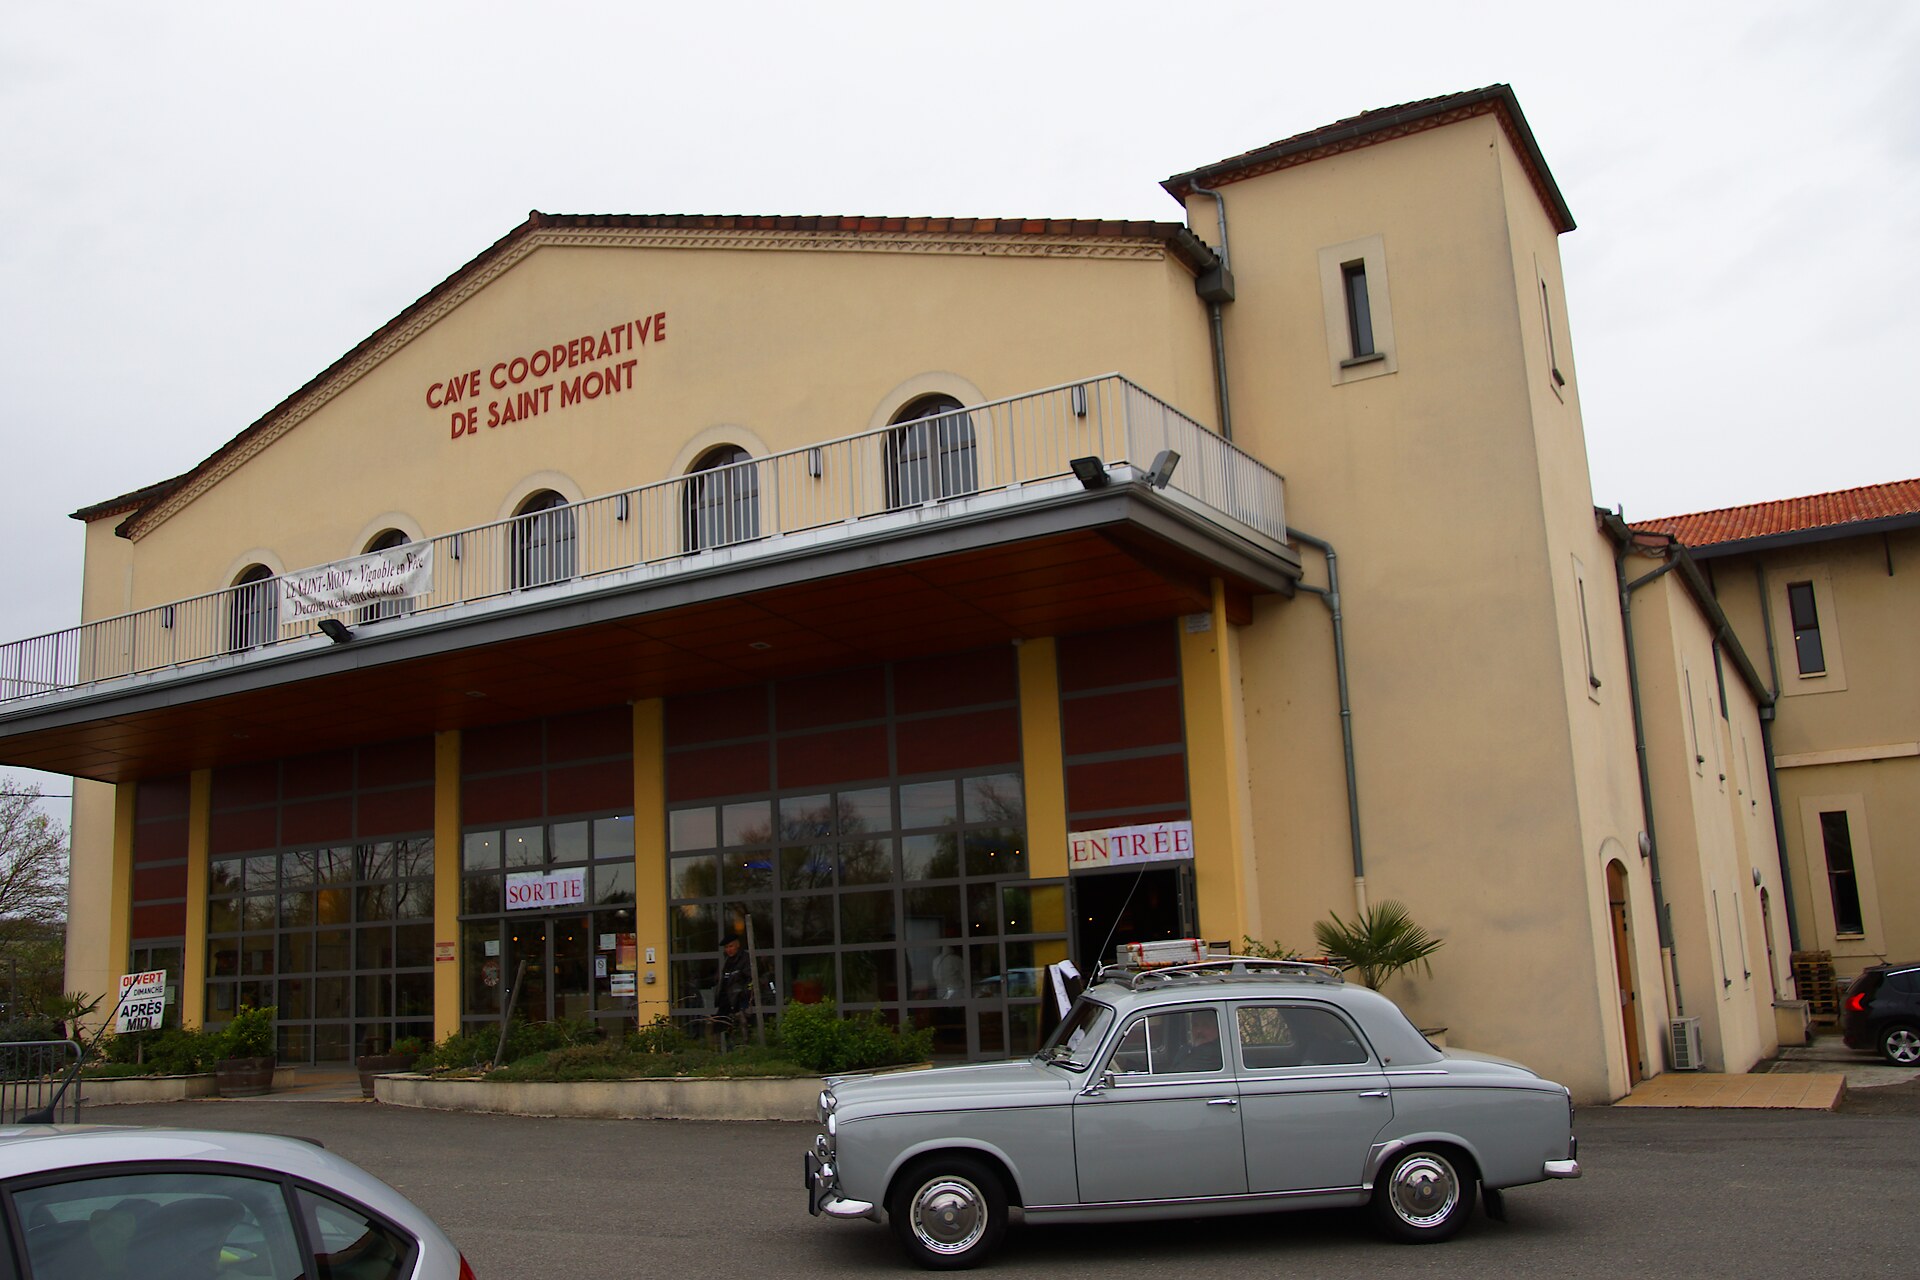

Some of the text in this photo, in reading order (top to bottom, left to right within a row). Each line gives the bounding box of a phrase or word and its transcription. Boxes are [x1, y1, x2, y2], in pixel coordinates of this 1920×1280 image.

[426, 311, 666, 409] CAVE COOPERATIVE
[451, 359, 638, 440] DE SAINT MONT
[360, 559, 394, 584] Vignoble
[396, 564, 405, 574] en
[294, 597, 326, 616] Dernier
[1072, 825, 1190, 862] ENTRÉE
[509, 879, 582, 904] SORTIE
[123, 972, 163, 987] OUVERT
[133, 985, 163, 997] DIMANCHE
[120, 999, 162, 1018] APRÈS
[126, 1016, 153, 1031] MIDI
